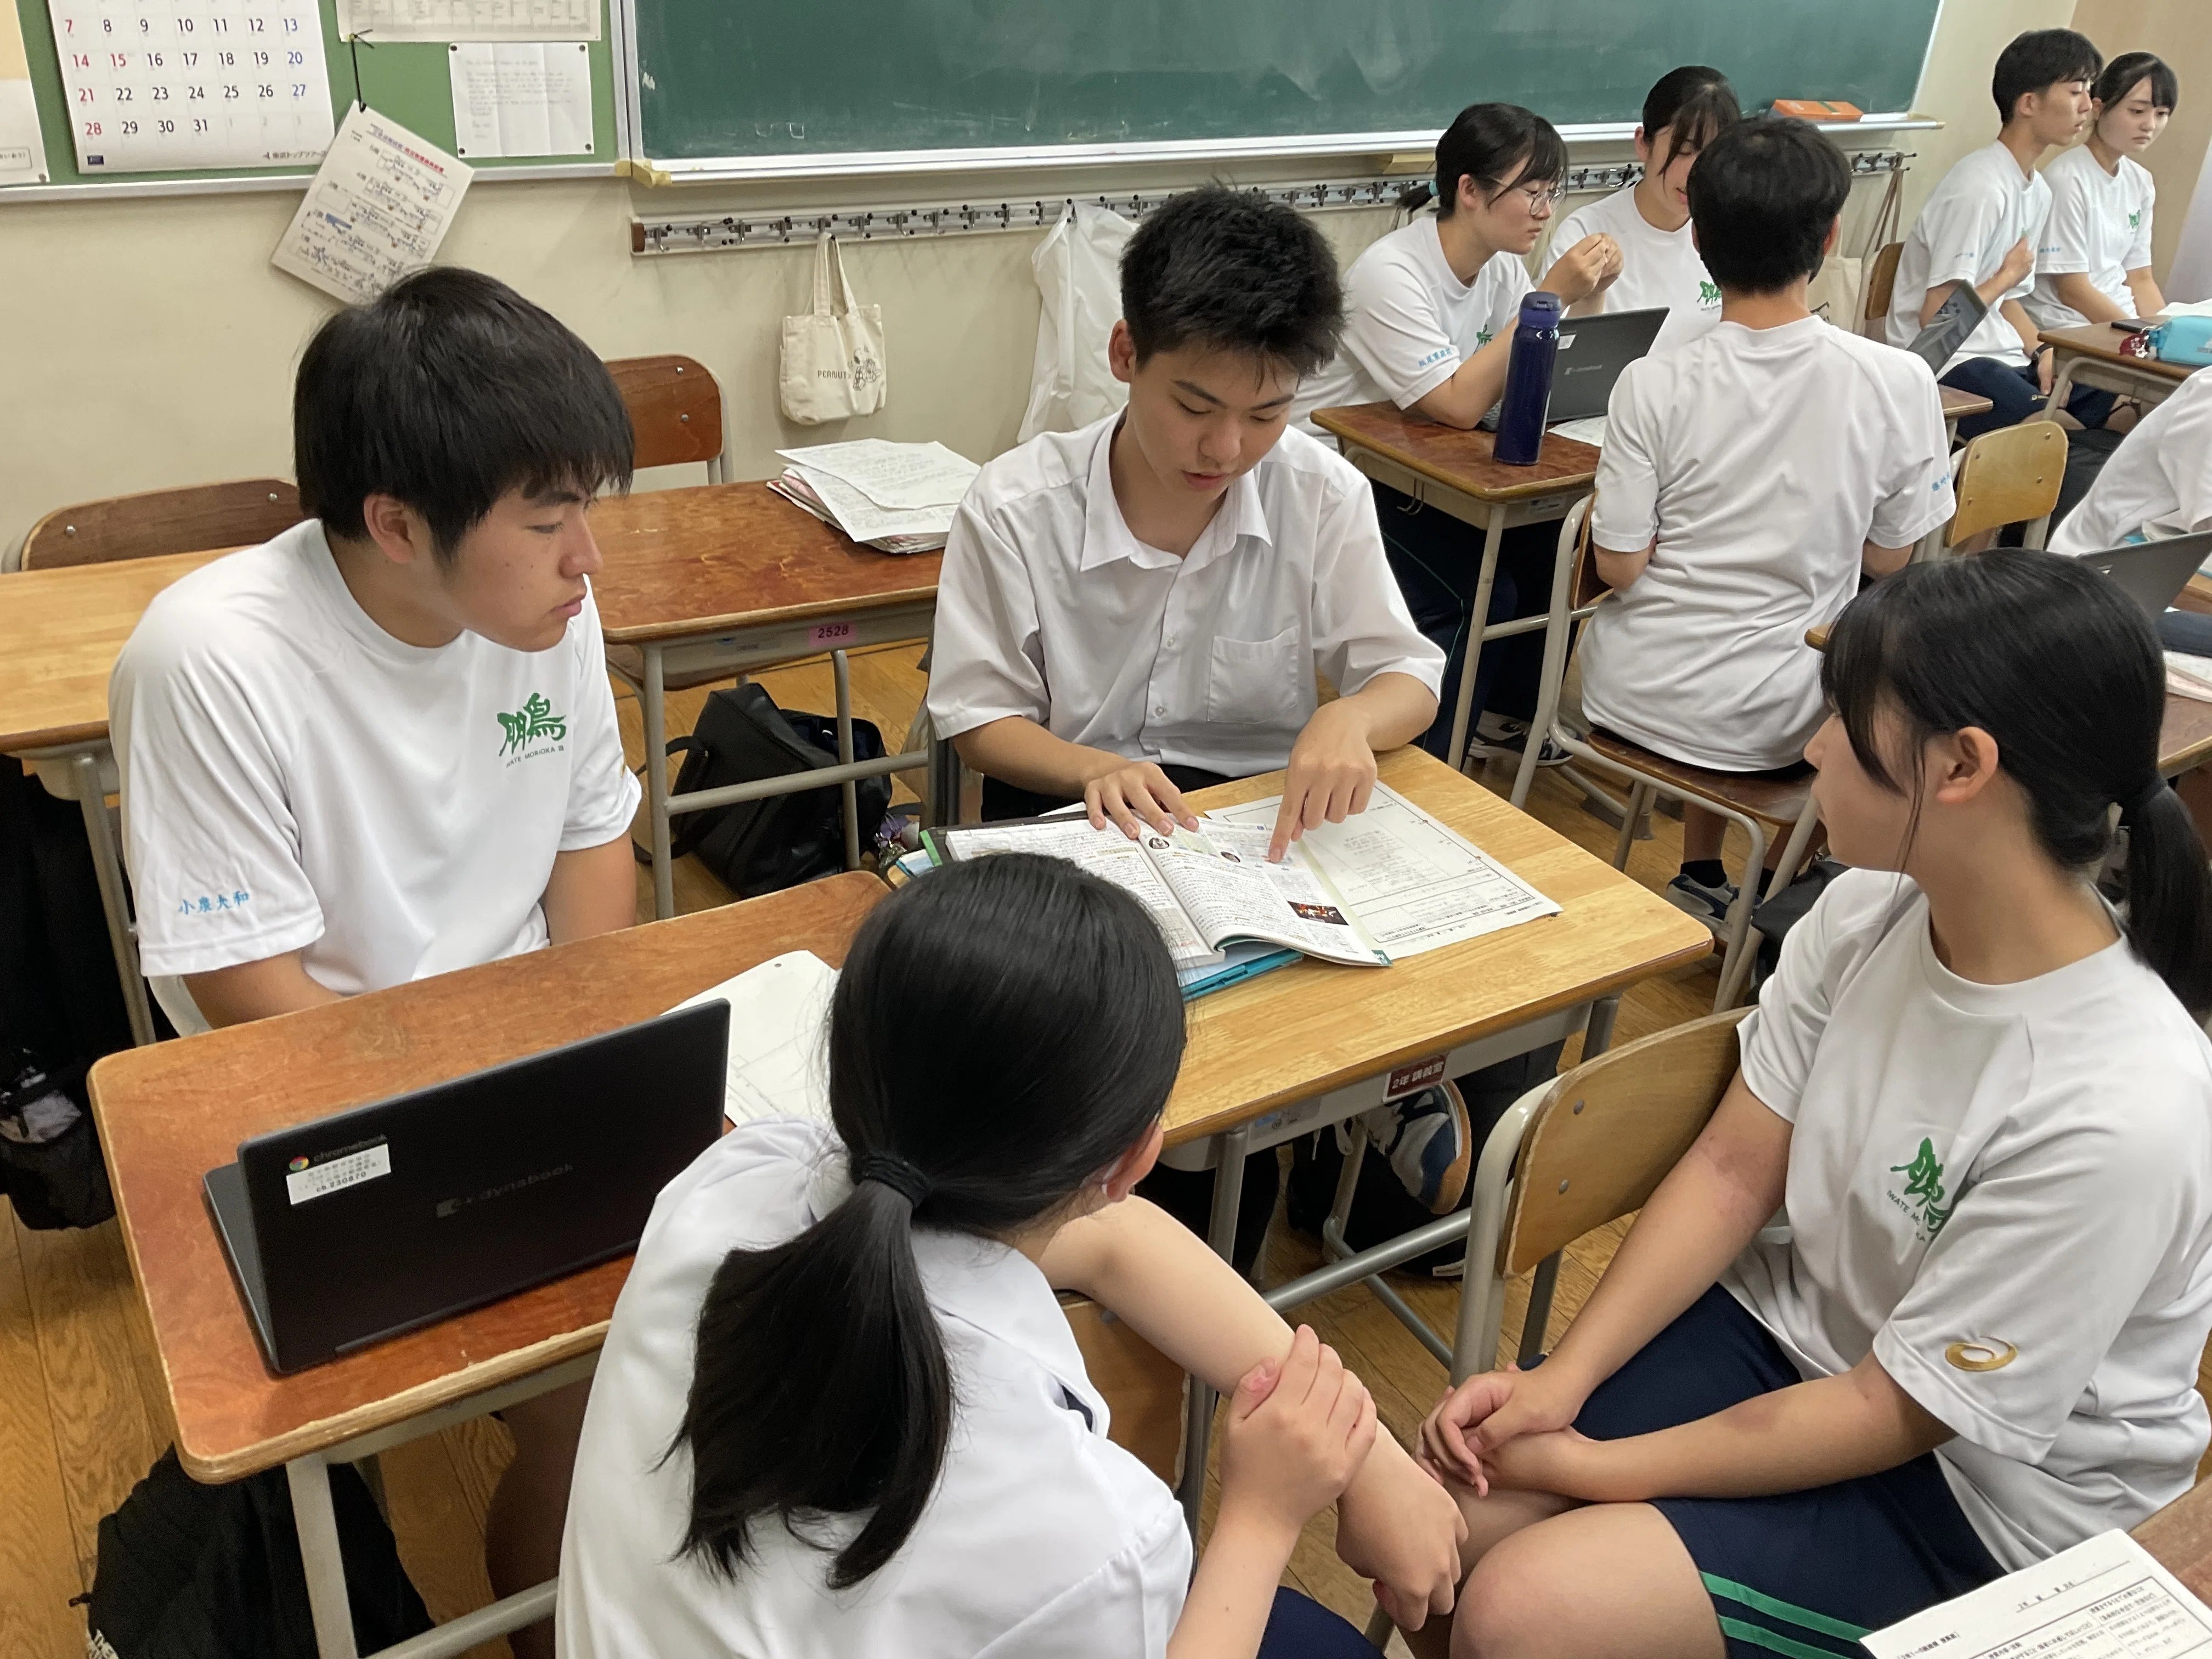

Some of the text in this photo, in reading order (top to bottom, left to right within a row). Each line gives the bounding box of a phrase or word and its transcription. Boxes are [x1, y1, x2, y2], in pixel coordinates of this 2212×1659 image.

[65, 18, 298, 33] 7 8 9 10 11 12 13
[73, 52, 302, 68] 14 15 16 17 18 19 20
[78, 84, 306, 102] 21 22 23 24 25 26 27
[85, 122, 102, 136] 28
[122, 121, 138, 134] 29
[158, 120, 174, 133] 30
[194, 119, 208, 132] 31
[818, 624, 849, 638] 2528
[524, 746, 555, 759] MORIOKA
[480, 1163, 573, 1200] dynabook
[1887, 1190, 1910, 1213] IWATE
